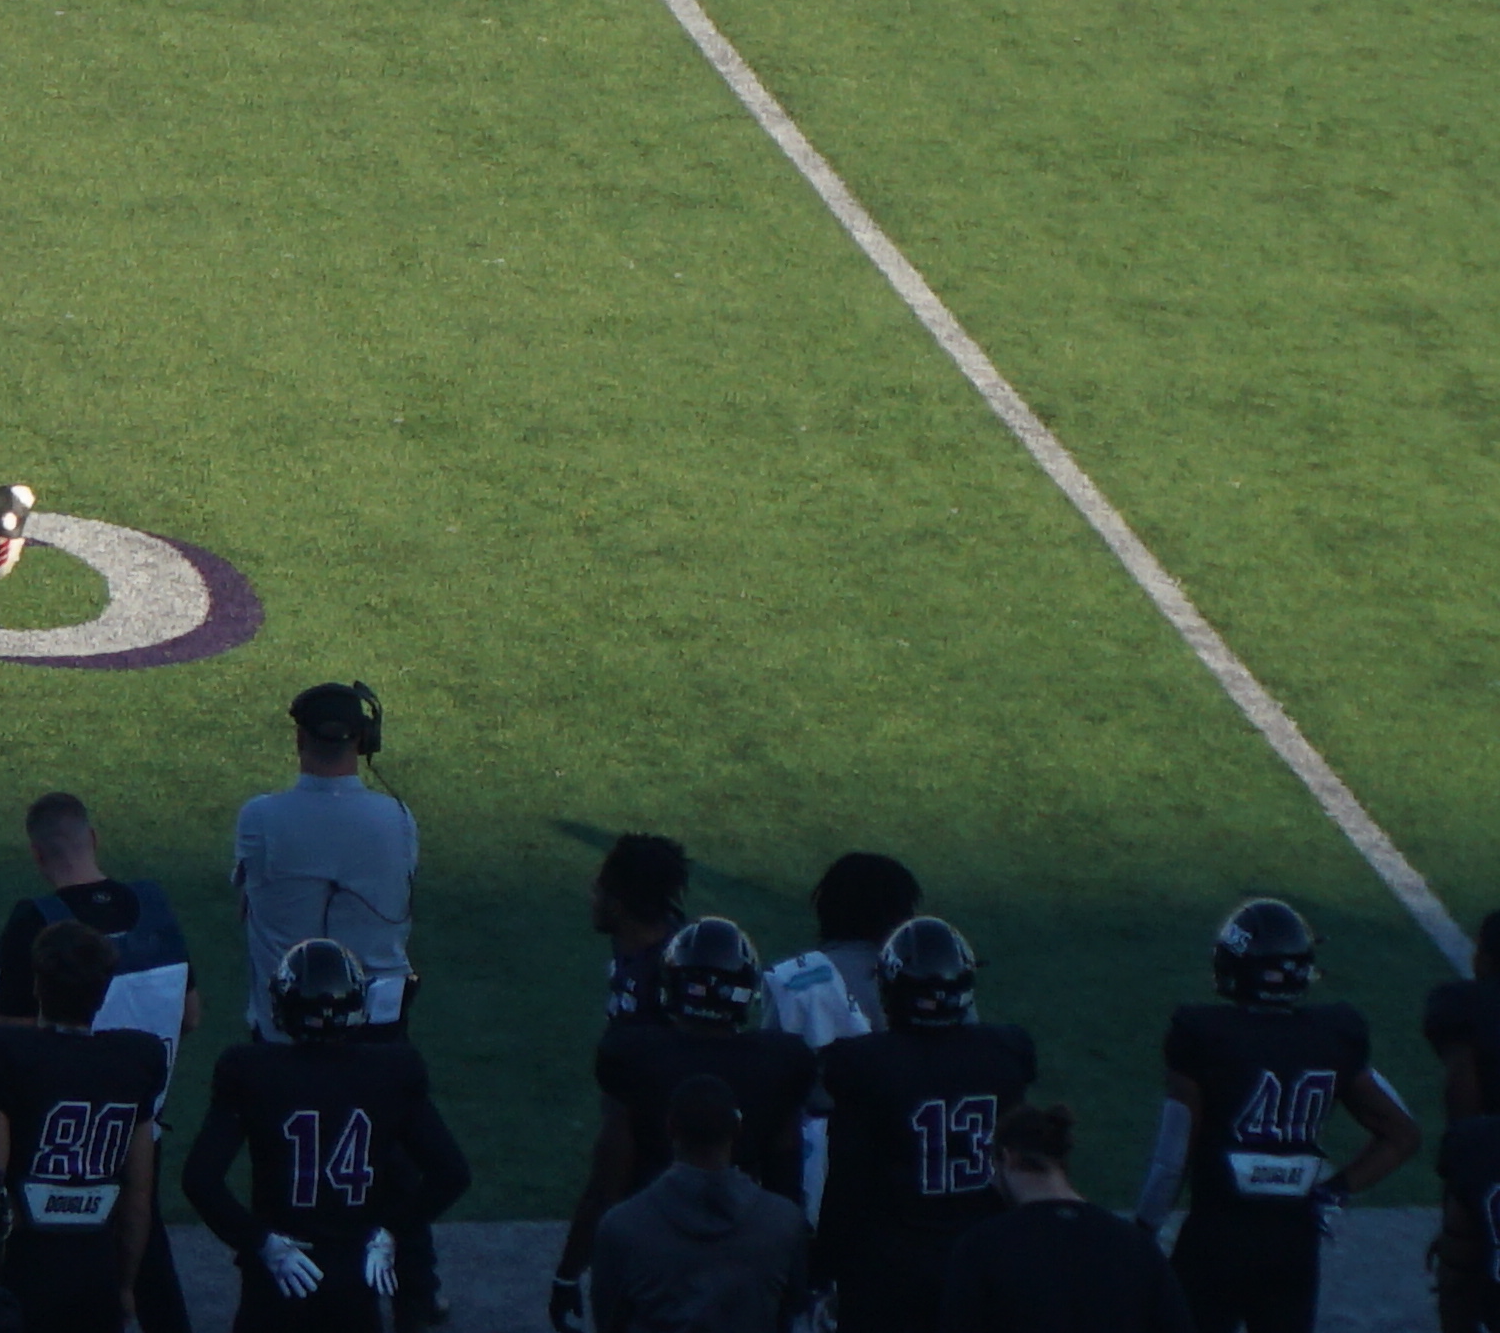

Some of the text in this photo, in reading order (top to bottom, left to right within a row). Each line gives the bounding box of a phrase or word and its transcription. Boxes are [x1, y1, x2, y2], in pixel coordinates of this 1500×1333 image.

[32, 1100, 139, 1181] 80
[911, 1094, 999, 1196] 13
[1233, 1070, 1338, 1143] 40
[283, 1107, 376, 1208] 14
